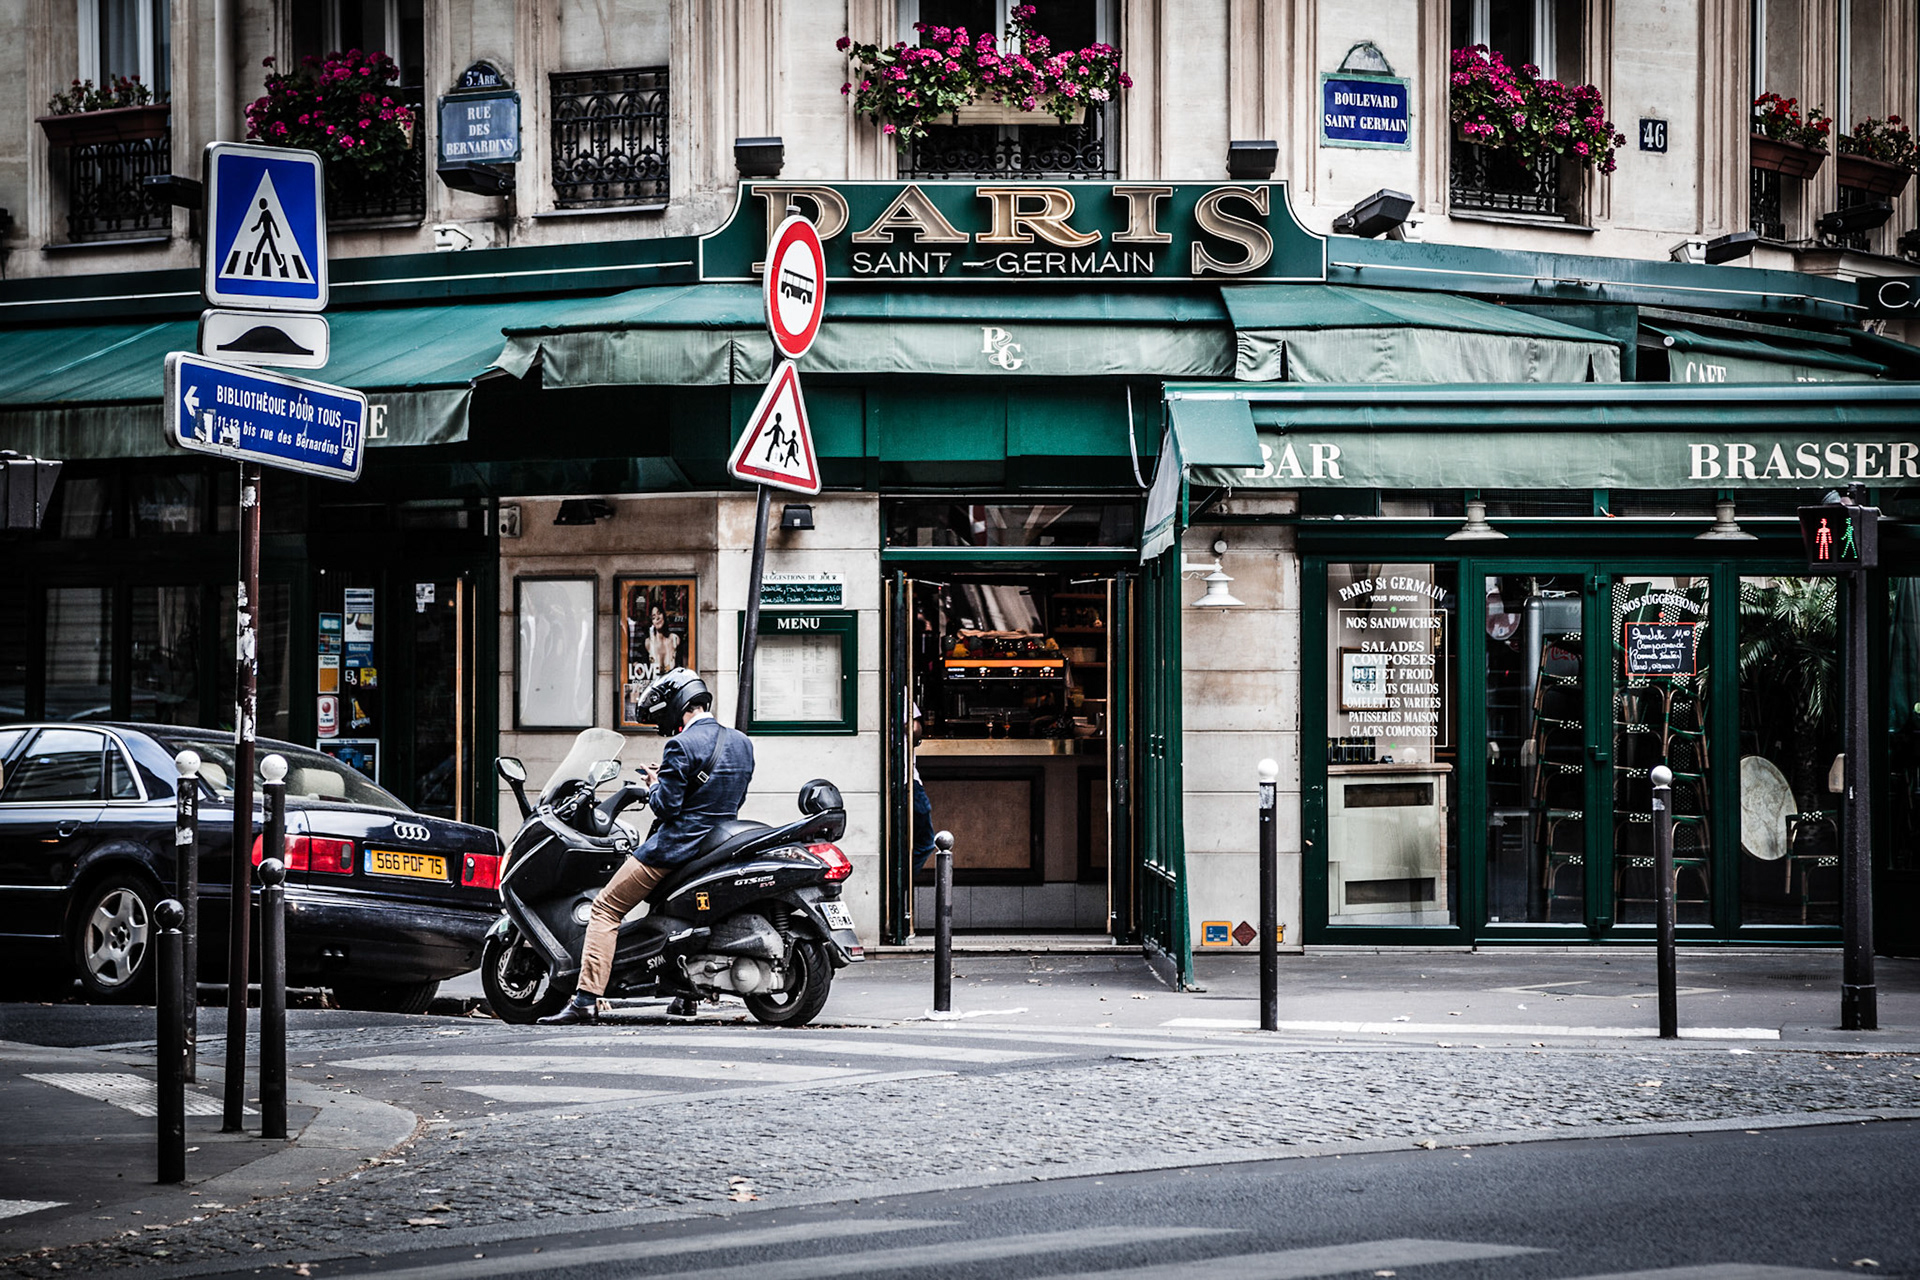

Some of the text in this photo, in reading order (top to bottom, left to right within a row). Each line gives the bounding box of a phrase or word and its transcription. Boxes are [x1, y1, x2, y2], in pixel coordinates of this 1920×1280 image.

[1334, 92, 1398, 108] BOULEVARD
[467, 106, 491, 120] RUE
[469, 123, 490, 136] DES
[1325, 114, 1407, 132] SAINT GERMAIN
[1643, 122, 1665, 148] 46
[446, 139, 514, 156] BERNARDINS
[751, 185, 1274, 276] PARIS
[853, 252, 952, 275] SAINT
[996, 252, 1155, 275] GERMAIN
[1878, 281, 1920, 309] C
[216, 384, 341, 428] BIBLIOTHÈQUE POUR TOUS
[243, 421, 256, 437] bis
[260, 428, 274, 441] rue
[277, 429, 292, 445] des
[295, 433, 339, 455] Bernardins
[1242, 443, 1344, 479] BAR
[1339, 576, 1447, 601] PARIS St GERMAIN
[1622, 597, 1641, 615] NOS
[777, 618, 820, 629] MENU
[1346, 617, 1441, 629] NOS SANDWICHES
[1361, 641, 1425, 653] SALADES
[1352, 653, 1436, 666] COMPOSEES
[1353, 668, 1433, 680] BUFFET FROID
[1348, 683, 1439, 694] NOS PLATS CHAUDS
[1346, 697, 1441, 708] OMELETTES VARIEES
[1348, 711, 1439, 722] PATISSERIES MAISON
[1350, 725, 1438, 737] GLACES COMPOSEES
[377, 852, 400, 870] 566
[428, 858, 442, 875] 75
[646, 954, 667, 969] SYM
